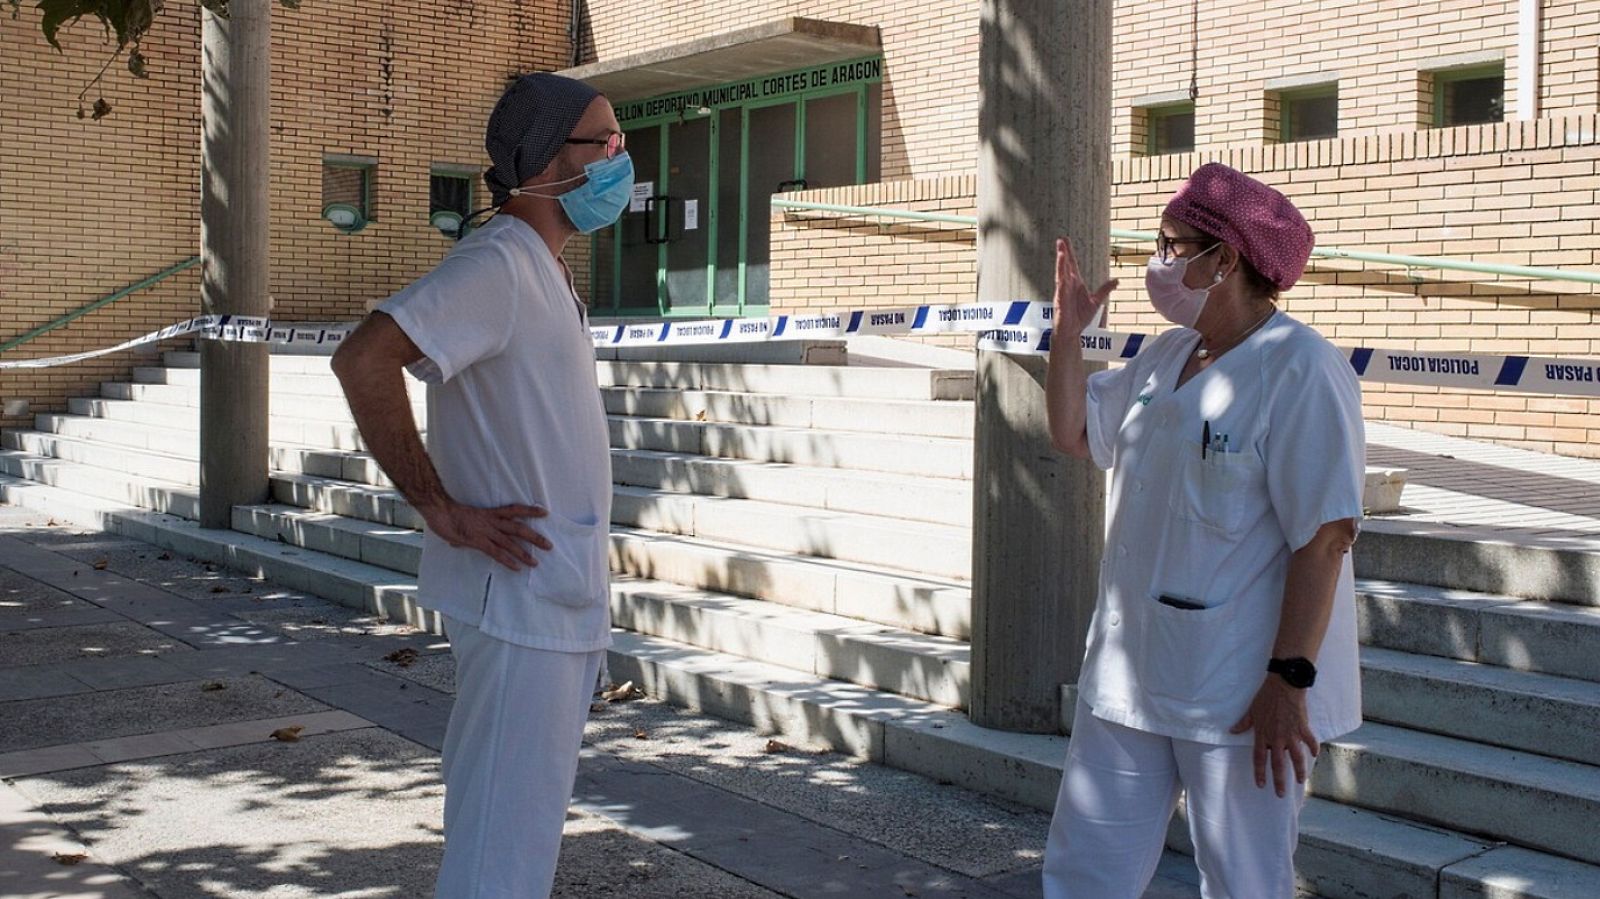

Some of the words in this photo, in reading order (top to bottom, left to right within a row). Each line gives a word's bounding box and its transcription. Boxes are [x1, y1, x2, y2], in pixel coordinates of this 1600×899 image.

[614, 103, 643, 121] ELLON
[646, 92, 699, 117] DEPORTIVO
[702, 82, 758, 107] MUNICIPAL
[763, 72, 806, 96] CORTES
[811, 69, 827, 88] DE
[832, 59, 880, 84] ARAGON
[870, 313, 894, 326] PASAR
[895, 312, 905, 324] NO
[938, 308, 961, 321] LOCAL
[963, 307, 994, 320] POLICIA
[794, 319, 814, 330] LOCAL
[814, 316, 841, 328] POLICIA
[1080, 335, 1097, 350] PAS
[1098, 336, 1112, 350] NO
[1387, 355, 1426, 372] LOCAL
[1428, 358, 1479, 375] POLICIA
[1545, 364, 1593, 382] PASAR
